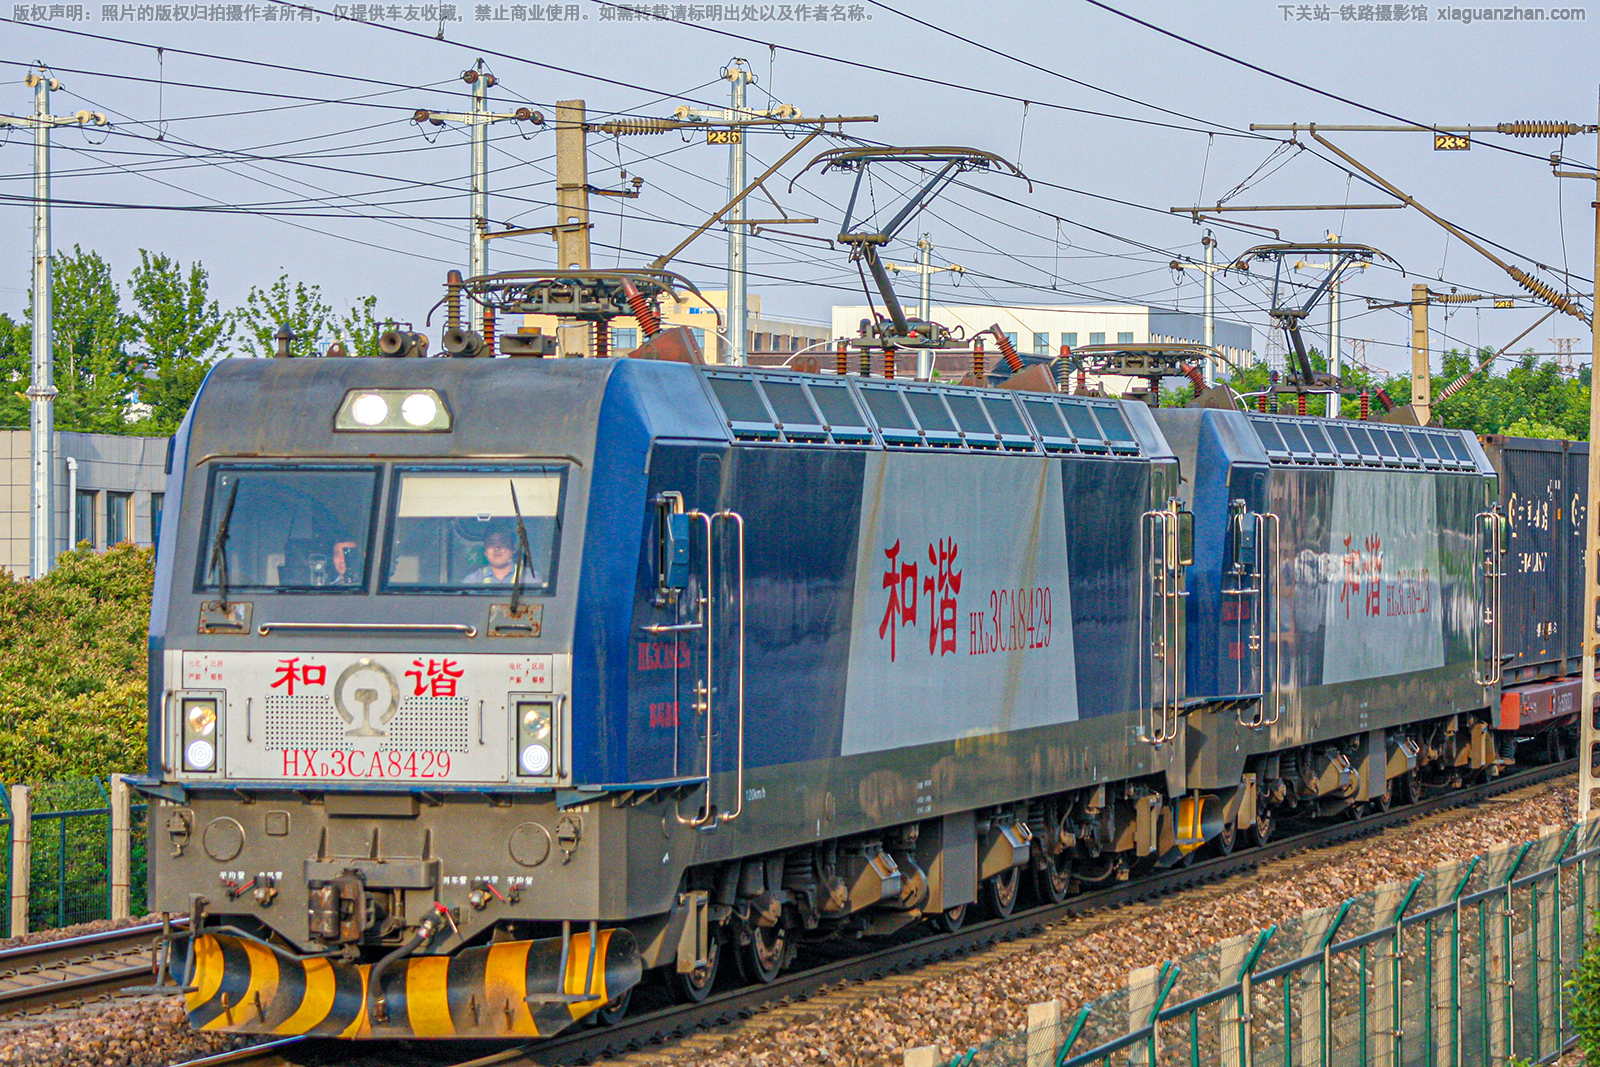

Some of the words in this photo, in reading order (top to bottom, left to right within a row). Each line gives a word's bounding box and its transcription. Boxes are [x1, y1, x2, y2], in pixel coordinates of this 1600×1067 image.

[710, 131, 739, 143] 236
[1437, 136, 1468, 149] 233
[1340, 533, 1383, 620] 和谐
[879, 536, 962, 662] 和谐
[270, 656, 328, 697] 和
[404, 657, 465, 699] 谐
[282, 749, 452, 779] HXD3CA8429
